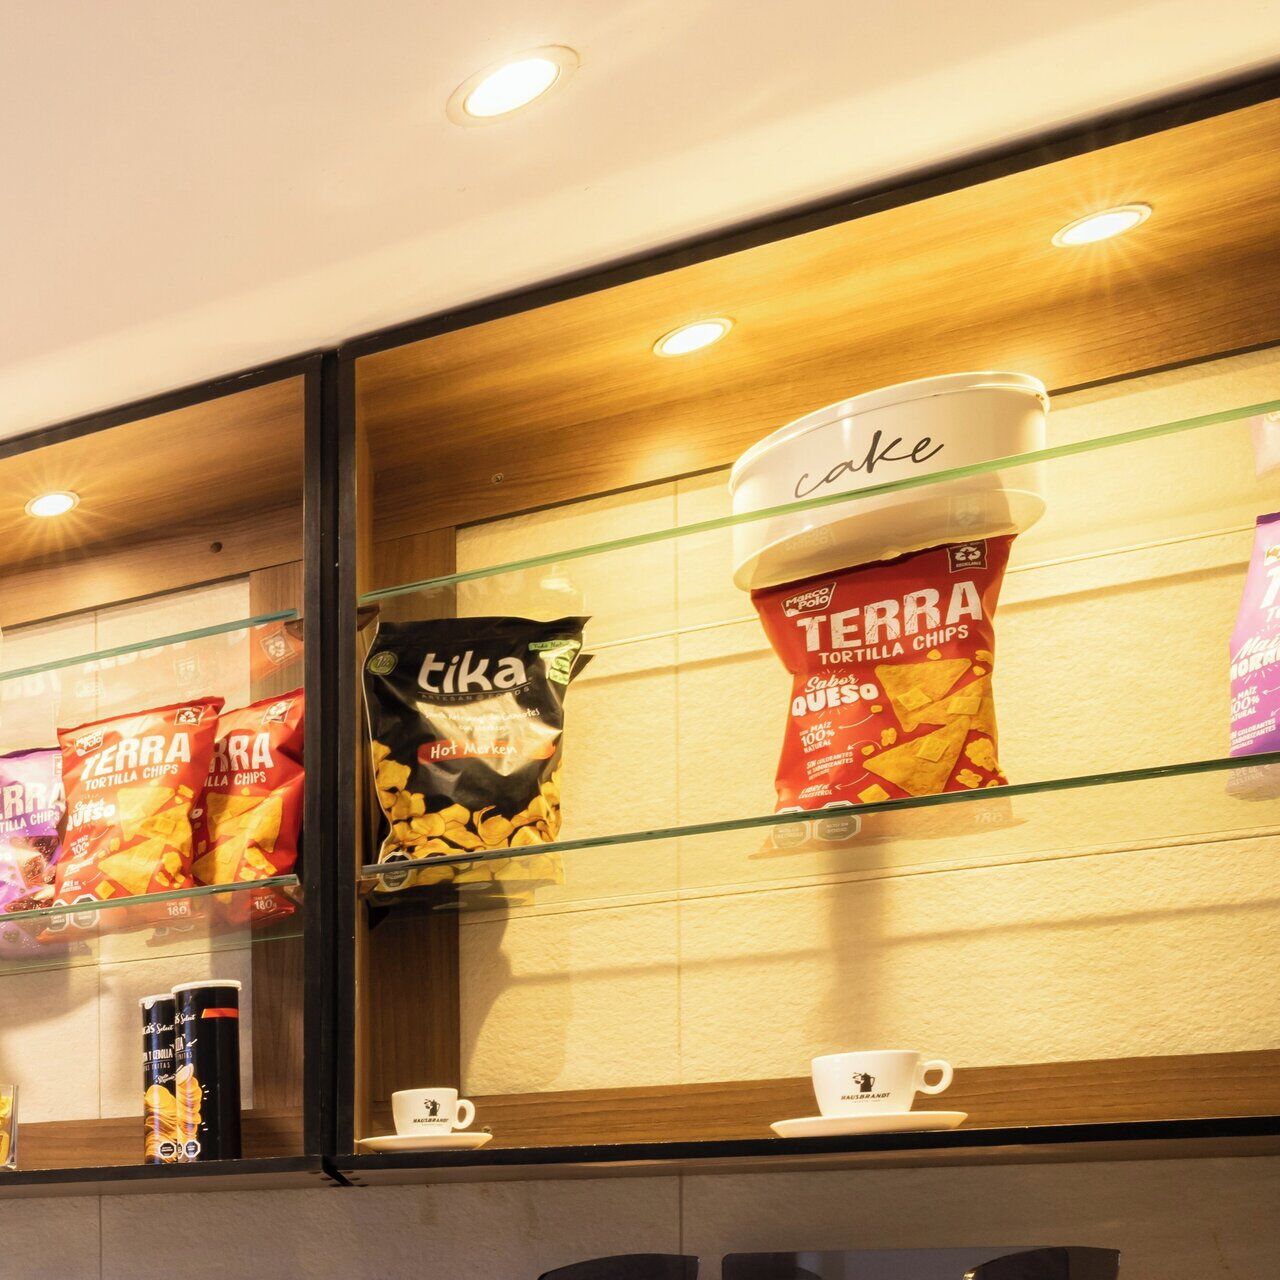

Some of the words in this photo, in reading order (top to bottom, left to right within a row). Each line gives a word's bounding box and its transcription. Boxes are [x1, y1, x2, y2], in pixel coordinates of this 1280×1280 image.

[795, 430, 944, 498] cake
[786, 587, 829, 607] MARCO
[797, 581, 983, 652] TERRA
[818, 642, 905, 665] TORTILLA
[912, 624, 970, 651] CHIPS
[417, 651, 528, 694] tika
[805, 673, 860, 693] Sabor
[792, 683, 879, 717] QUESO
[1231, 694, 1260, 714] 00%
[1231, 707, 1257, 724] ATURAL
[800, 729, 835, 747] 100%
[803, 740, 832, 754] NATURAL
[80, 732, 191, 781] TERRA
[209, 732, 275, 773] RRA
[431, 741, 458, 759] Hot
[464, 741, 517, 755] Merken
[85, 772, 138, 791] TORTILLA
[142, 764, 179, 779] CHIPS
[234, 771, 267, 786] CHIPS
[29, 809, 60, 828] CHIPS
